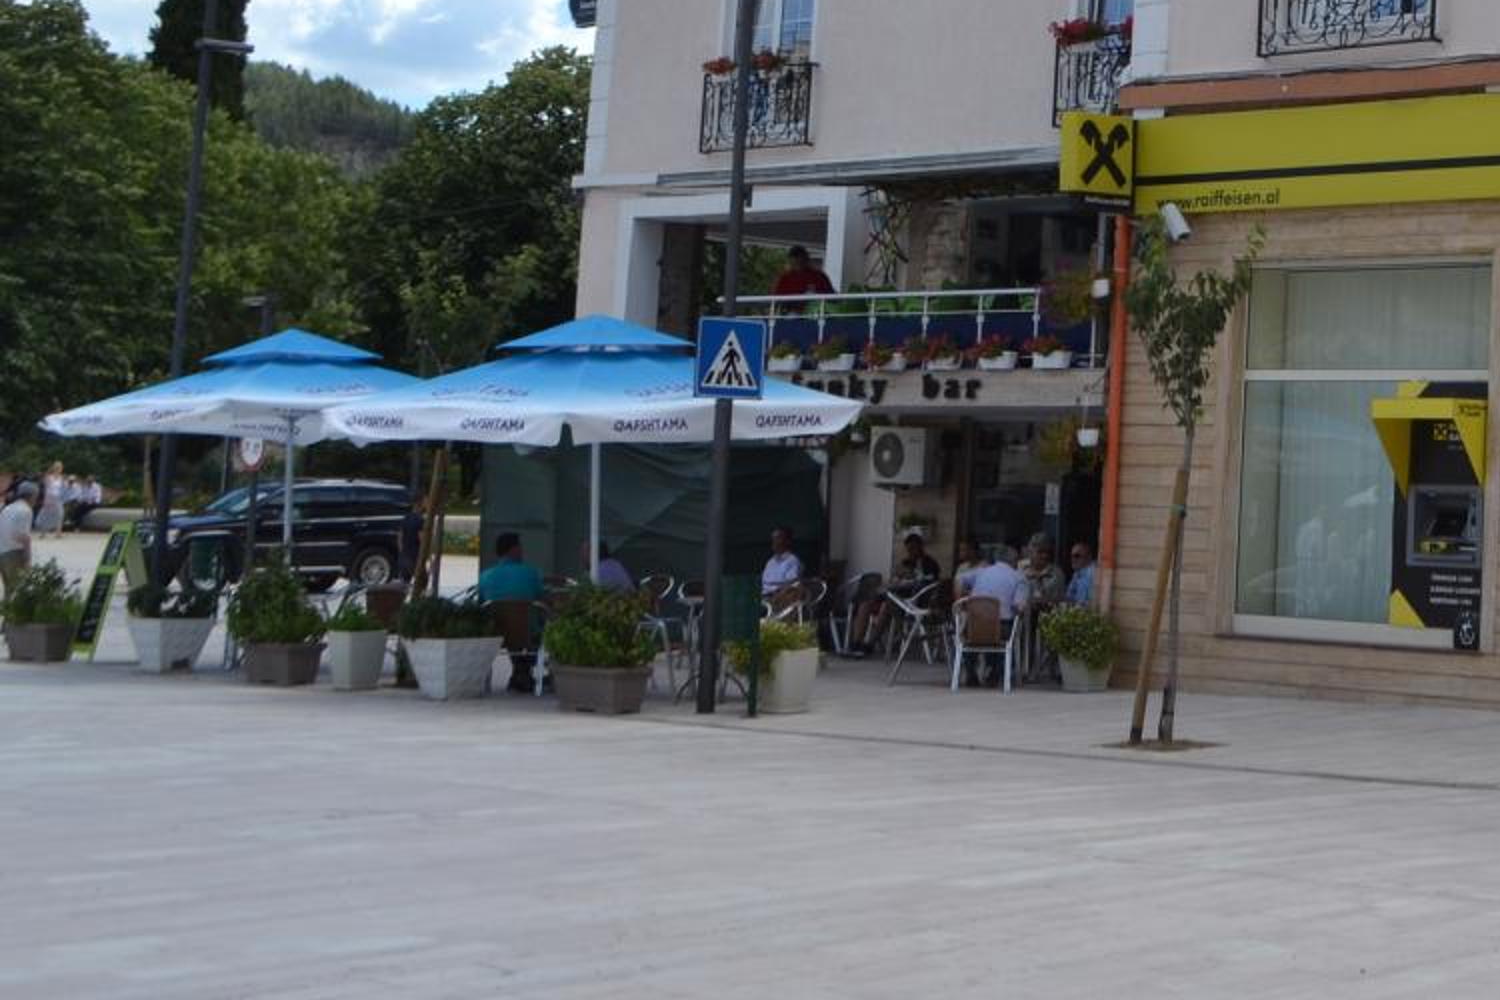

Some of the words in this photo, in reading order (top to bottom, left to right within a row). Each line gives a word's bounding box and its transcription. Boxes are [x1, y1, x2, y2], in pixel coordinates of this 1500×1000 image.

[1156, 188, 1280, 209] ww.raiffeisen.al
[790, 373, 888, 404] nky
[922, 373, 981, 400] bar
[613, 416, 689, 432] QAFSHTAMA
[755, 414, 824, 428] QAFSHTAMA
